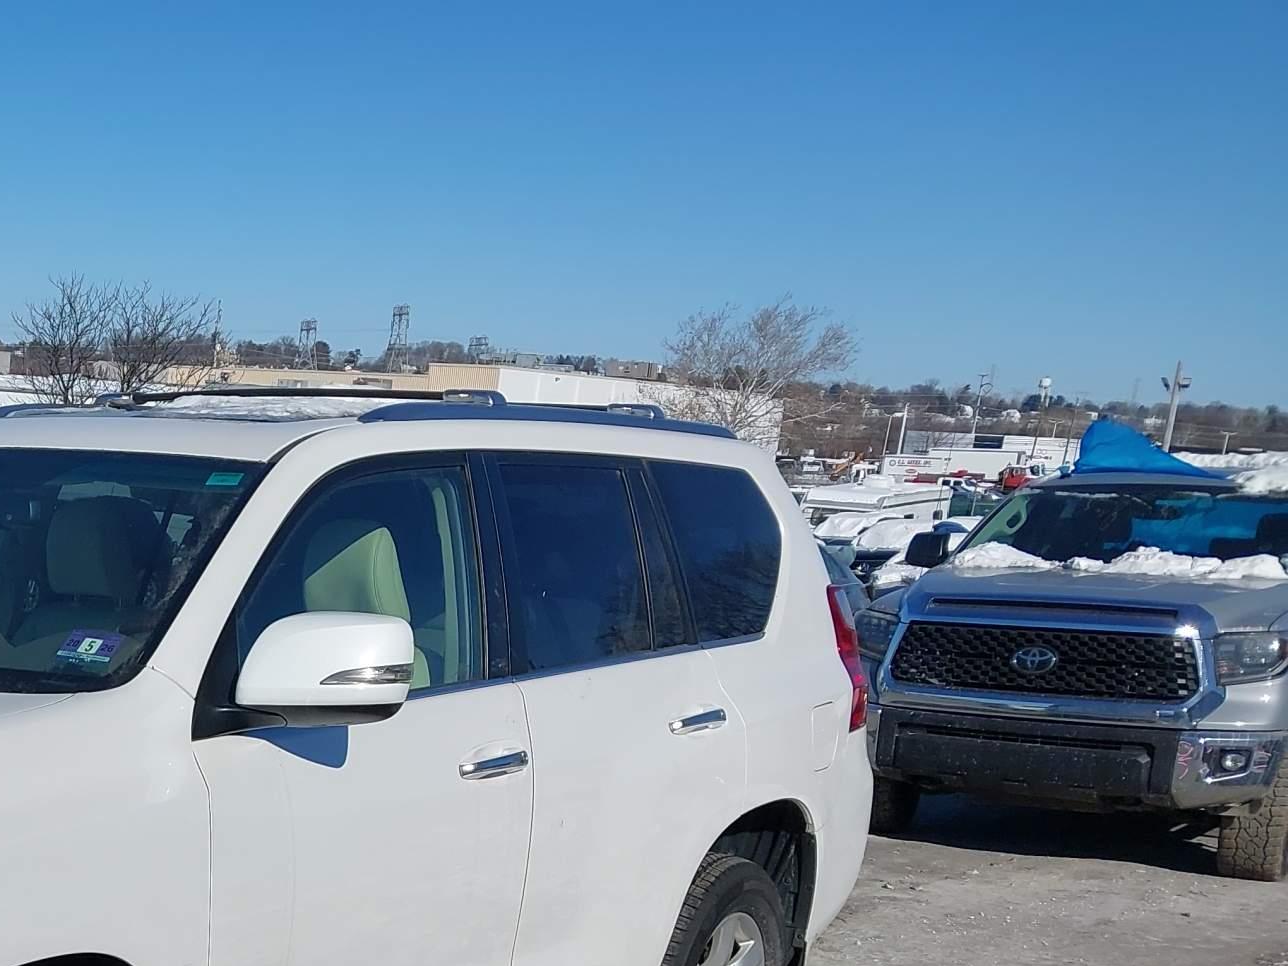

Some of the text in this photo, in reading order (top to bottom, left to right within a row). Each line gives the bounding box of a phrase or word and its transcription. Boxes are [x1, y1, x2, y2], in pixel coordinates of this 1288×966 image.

[66, 638, 115, 653] 20 5 26
